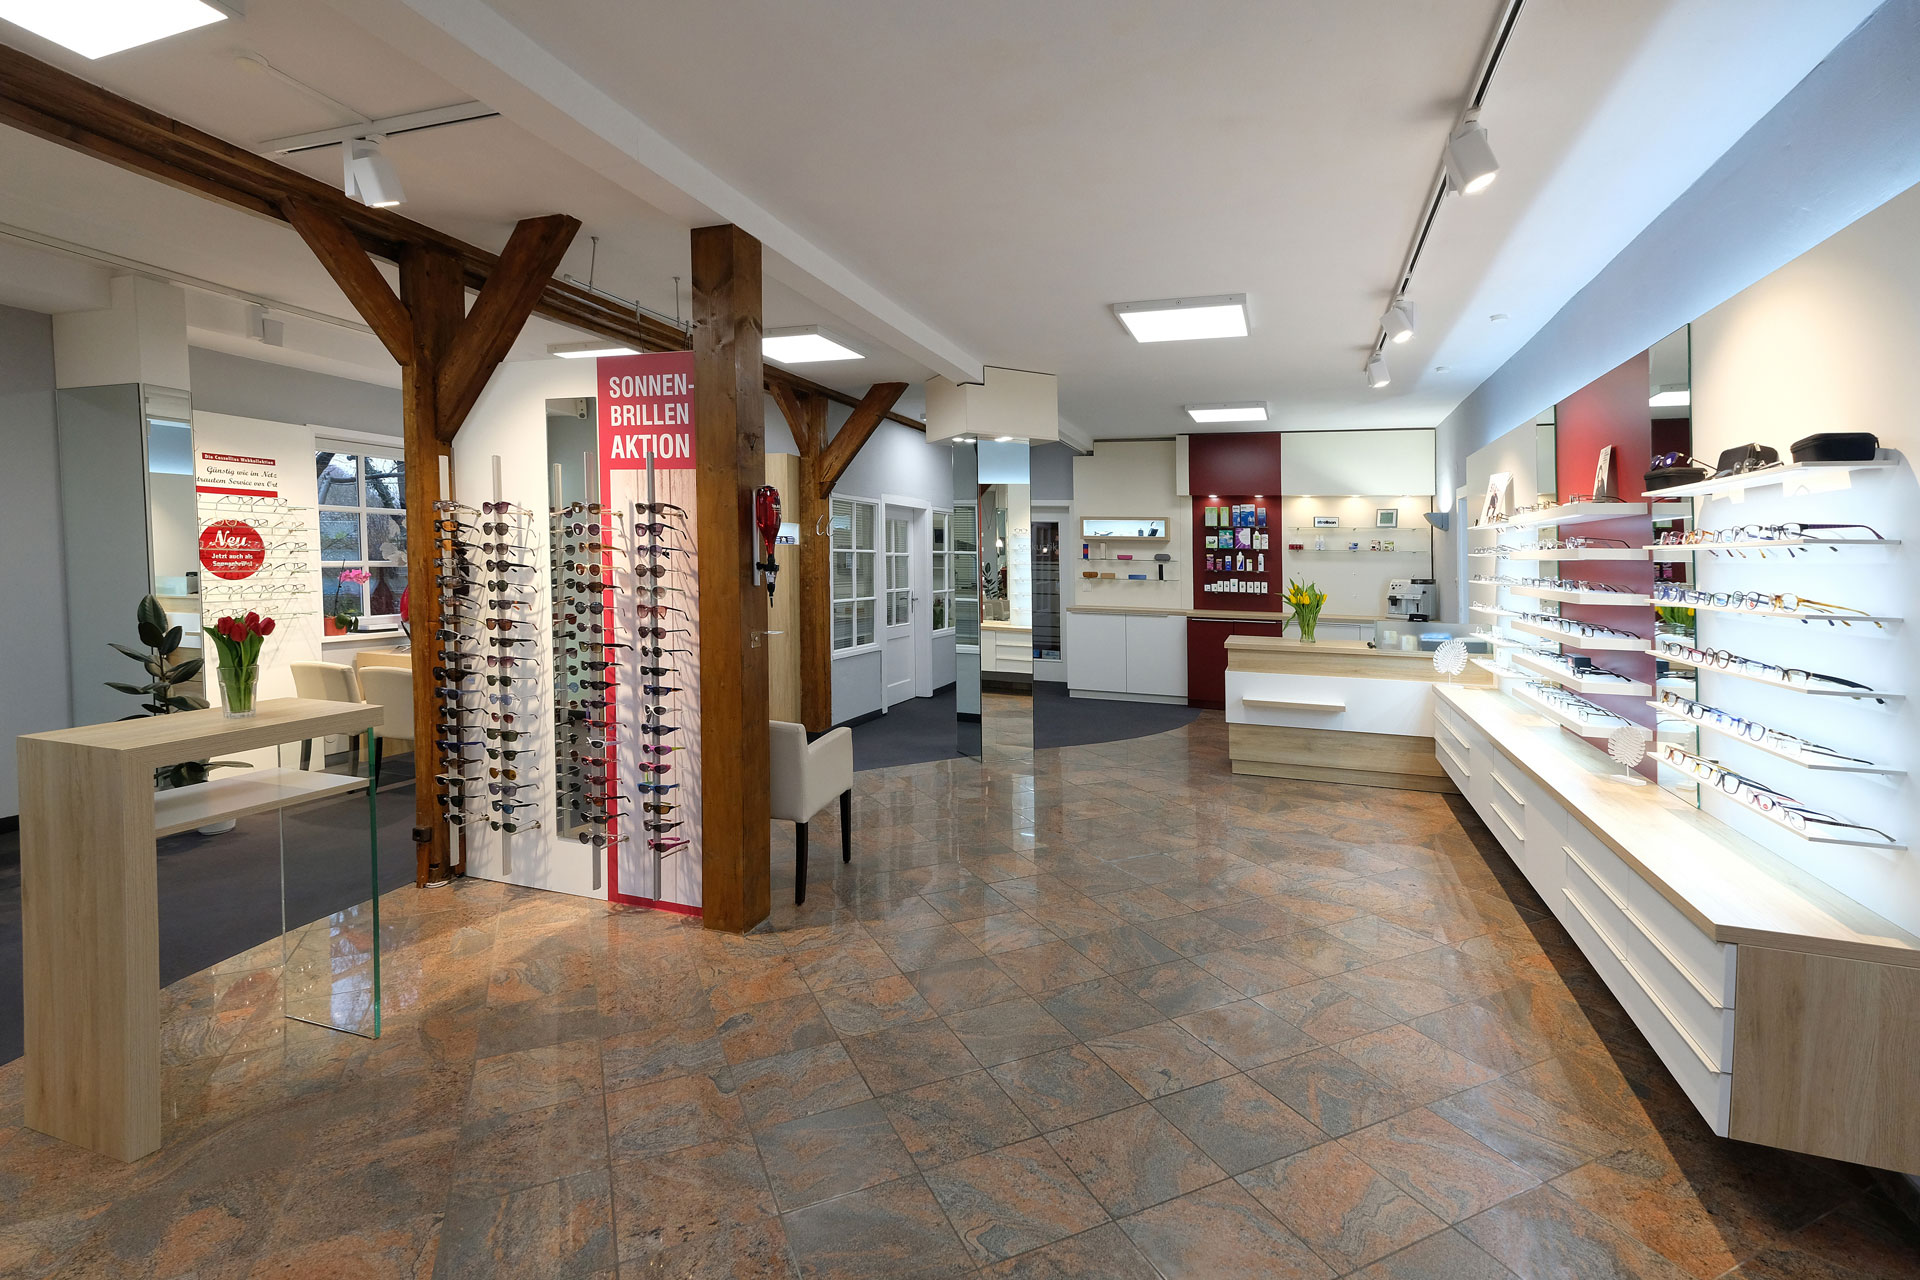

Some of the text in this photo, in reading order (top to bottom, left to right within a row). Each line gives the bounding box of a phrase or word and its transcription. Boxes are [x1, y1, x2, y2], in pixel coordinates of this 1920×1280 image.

[609, 373, 695, 398] SONNEN-
[610, 402, 689, 426] BRILLEN
[610, 433, 690, 459] AKTION
[196, 476, 226, 484] trautem
[228, 478, 252, 486] Service
[206, 466, 235, 476] Günstig
